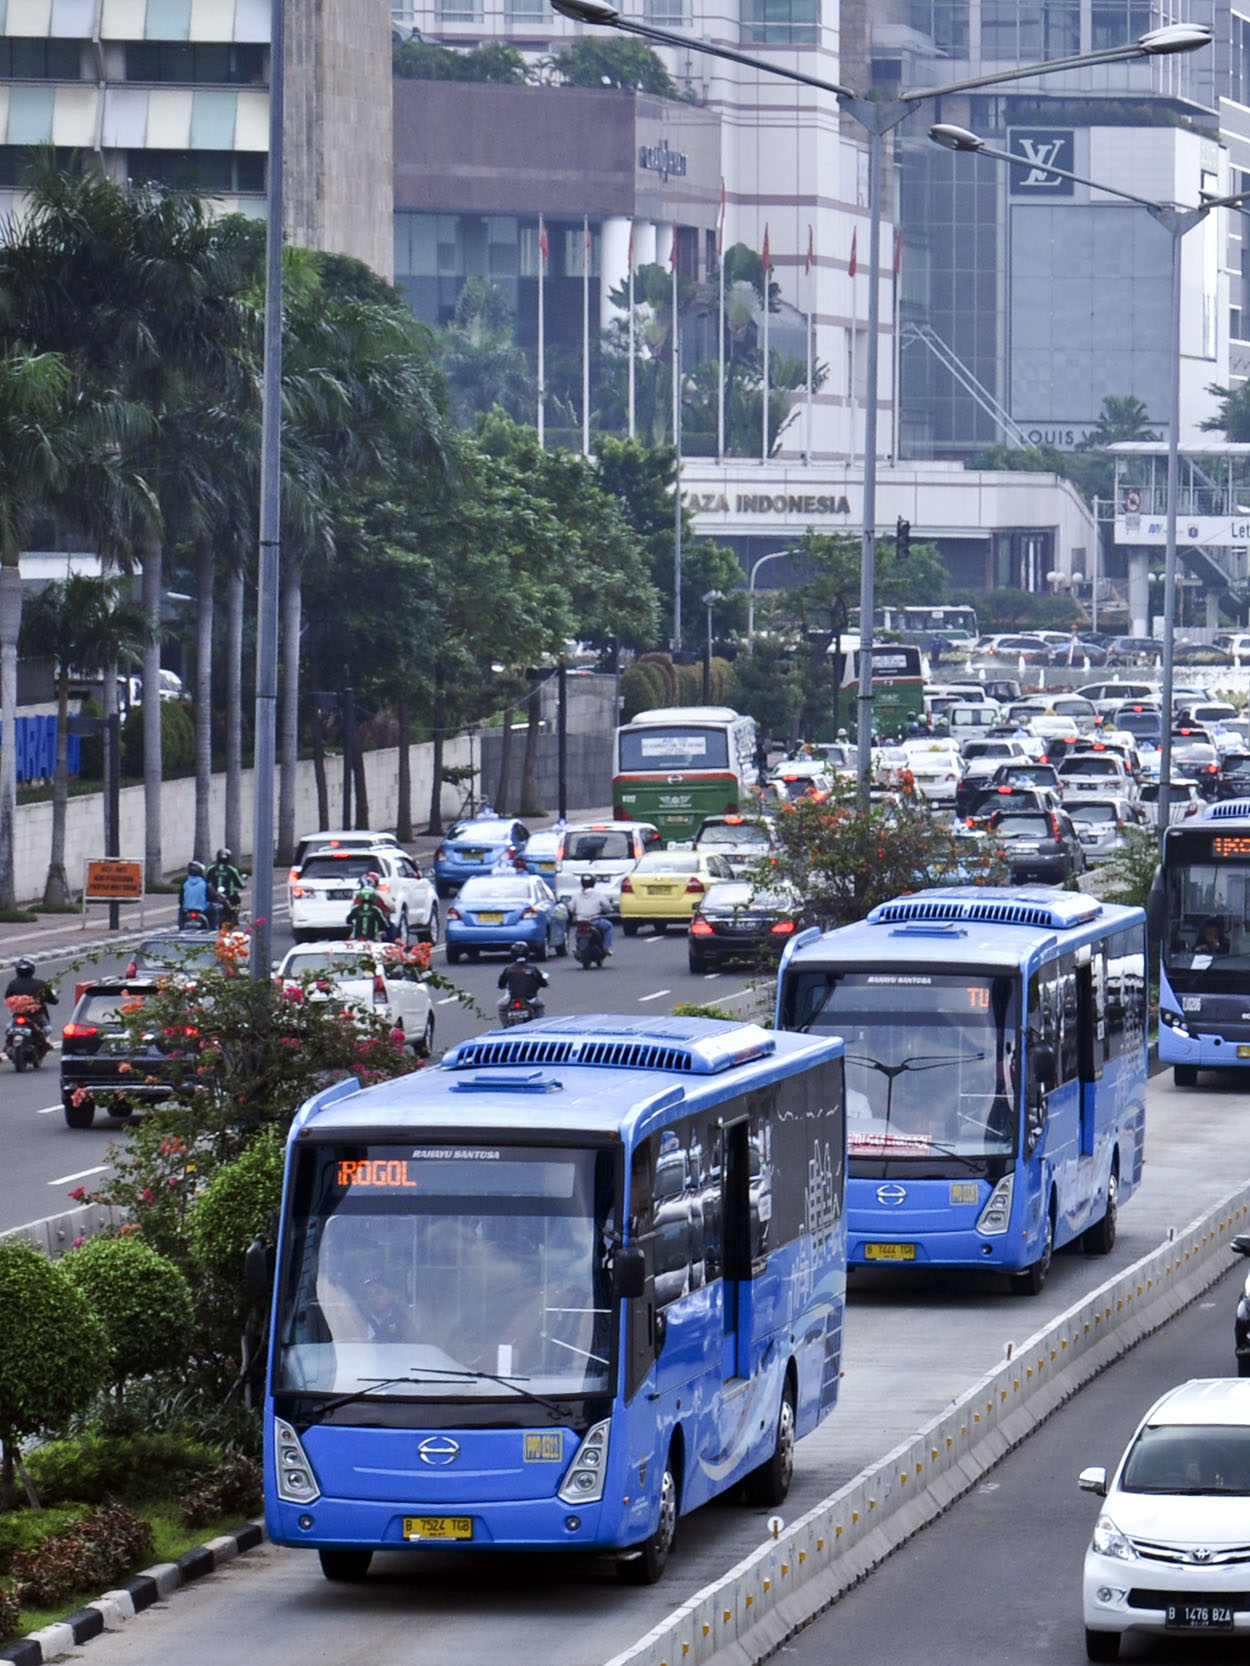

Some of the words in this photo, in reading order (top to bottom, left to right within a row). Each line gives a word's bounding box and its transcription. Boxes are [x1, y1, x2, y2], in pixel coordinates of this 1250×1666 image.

[1019, 430, 1075, 446] LOUIS
[688, 494, 730, 514] AZA
[735, 494, 851, 515] INDONESIA
[412, 1149, 451, 1159] RAHAYU
[453, 1150, 500, 1160] SANTOSA
[405, 1519, 413, 1532] B
[420, 1518, 446, 1532] 7524
[452, 1519, 470, 1532] TGB
[1168, 1606, 1176, 1620] B
[1185, 1607, 1209, 1621] 1476
[1212, 1608, 1231, 1622] BZA
